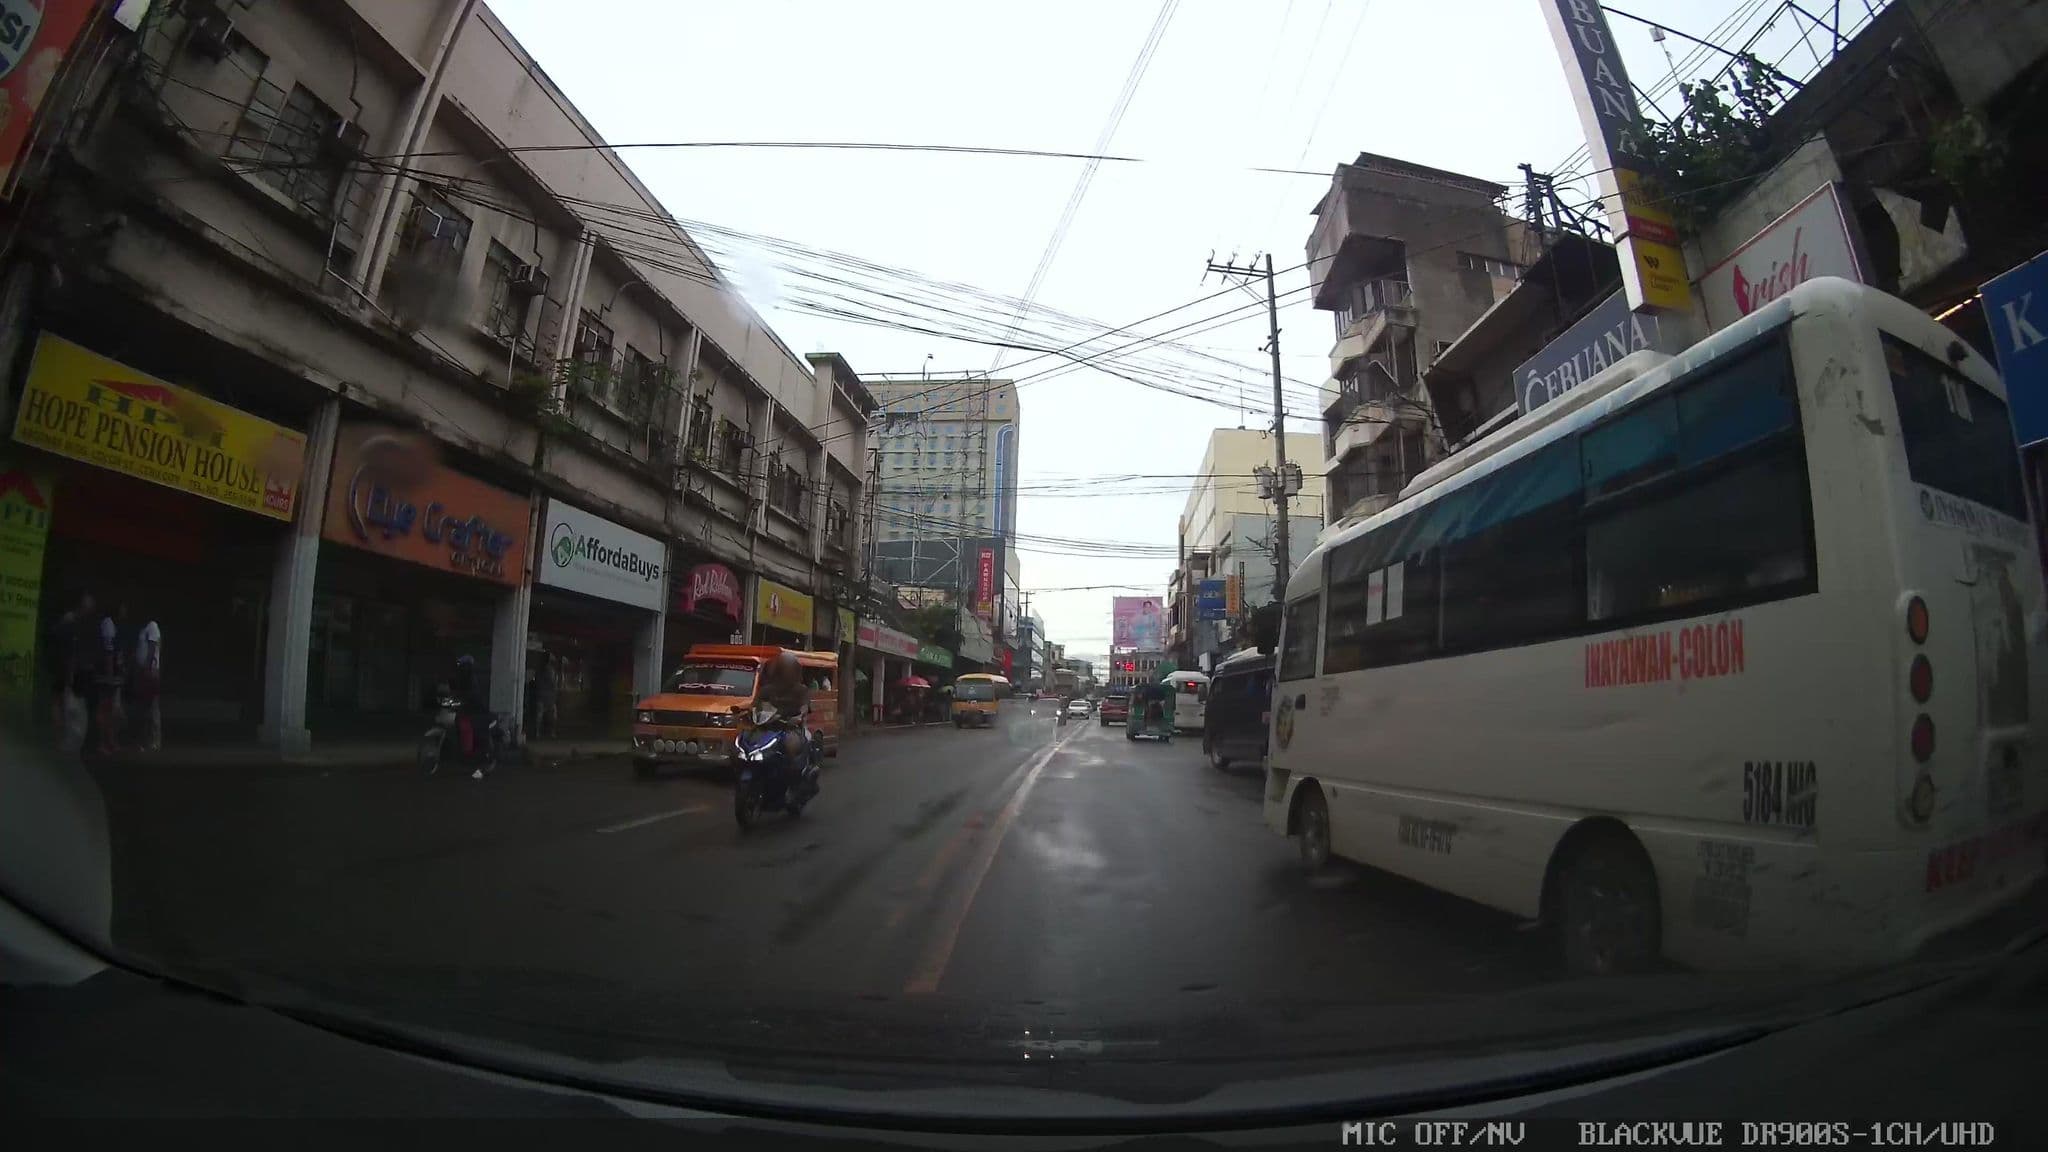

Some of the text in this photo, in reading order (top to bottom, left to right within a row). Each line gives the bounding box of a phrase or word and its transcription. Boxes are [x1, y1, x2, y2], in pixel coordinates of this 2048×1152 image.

[0, 4, 31, 52] SI
[25, 388, 90, 439] HOPE
[95, 411, 190, 473] PENSION
[193, 444, 260, 494] HOUSE
[423, 500, 513, 560] Crafter
[575, 534, 660, 582] AffordaBuys
[1585, 618, 1745, 688] INAYAWAN-COLON
[1743, 760, 1783, 824] 5184
